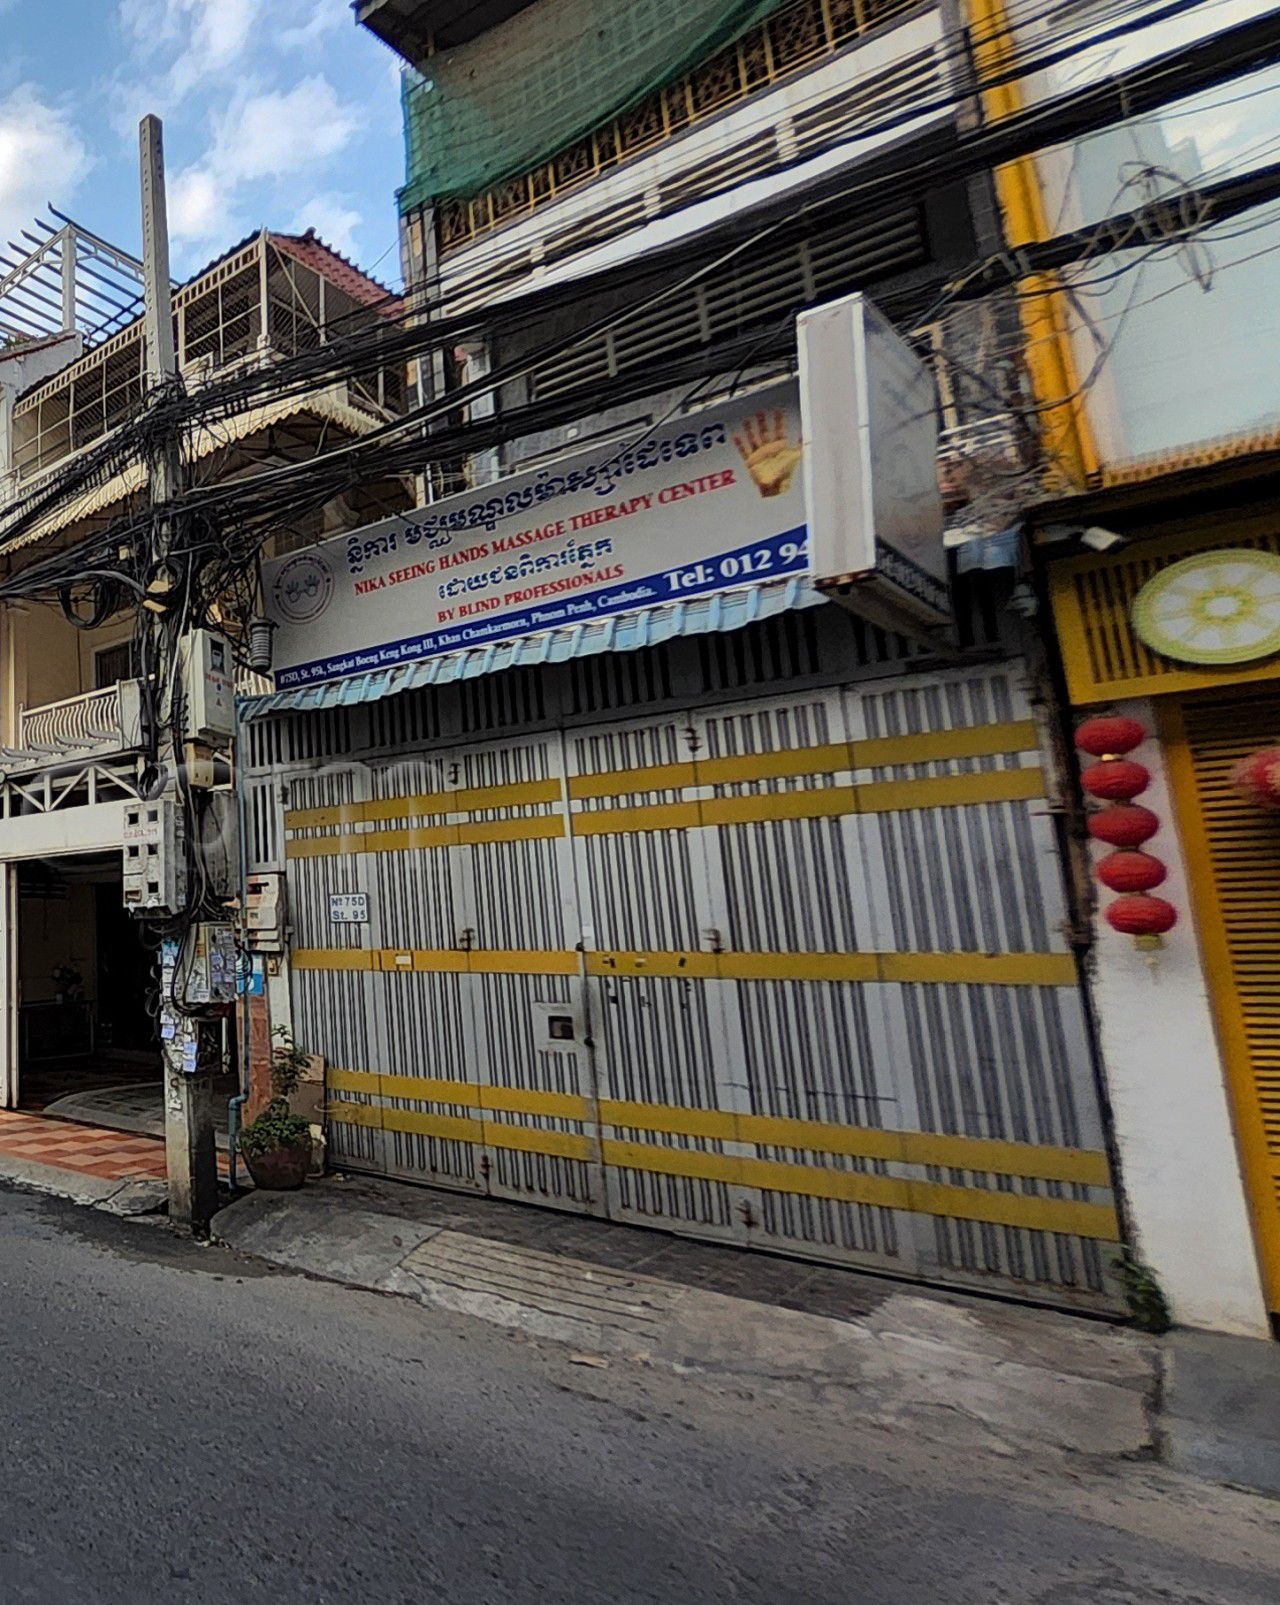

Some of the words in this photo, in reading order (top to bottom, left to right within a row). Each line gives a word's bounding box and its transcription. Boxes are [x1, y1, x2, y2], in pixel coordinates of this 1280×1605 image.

[354, 577, 385, 596] NIKA
[388, 560, 436, 586] SEEING
[439, 544, 489, 570] HANDS
[492, 522, 566, 555] MASSAGE
[568, 492, 654, 531] THERAPY
[658, 469, 737, 504] CENTER
[437, 607, 455, 623] BY
[459, 598, 501, 618] BLIND
[504, 564, 625, 606] PROFESSIONALS
[663, 563, 715, 592] Tel:
[720, 549, 773, 578] 012
[327, 659, 355, 673] Sangkat
[355, 654, 379, 666] Boeng
[379, 649, 400, 660] Keng
[400, 644, 422, 655] Kong
[438, 634, 461, 646] Khan
[531, 609, 566, 624] Phnom
[566, 600, 597, 616] Penh,
[345, 896, 365, 906] 75D
[352, 910, 366, 920] 95
